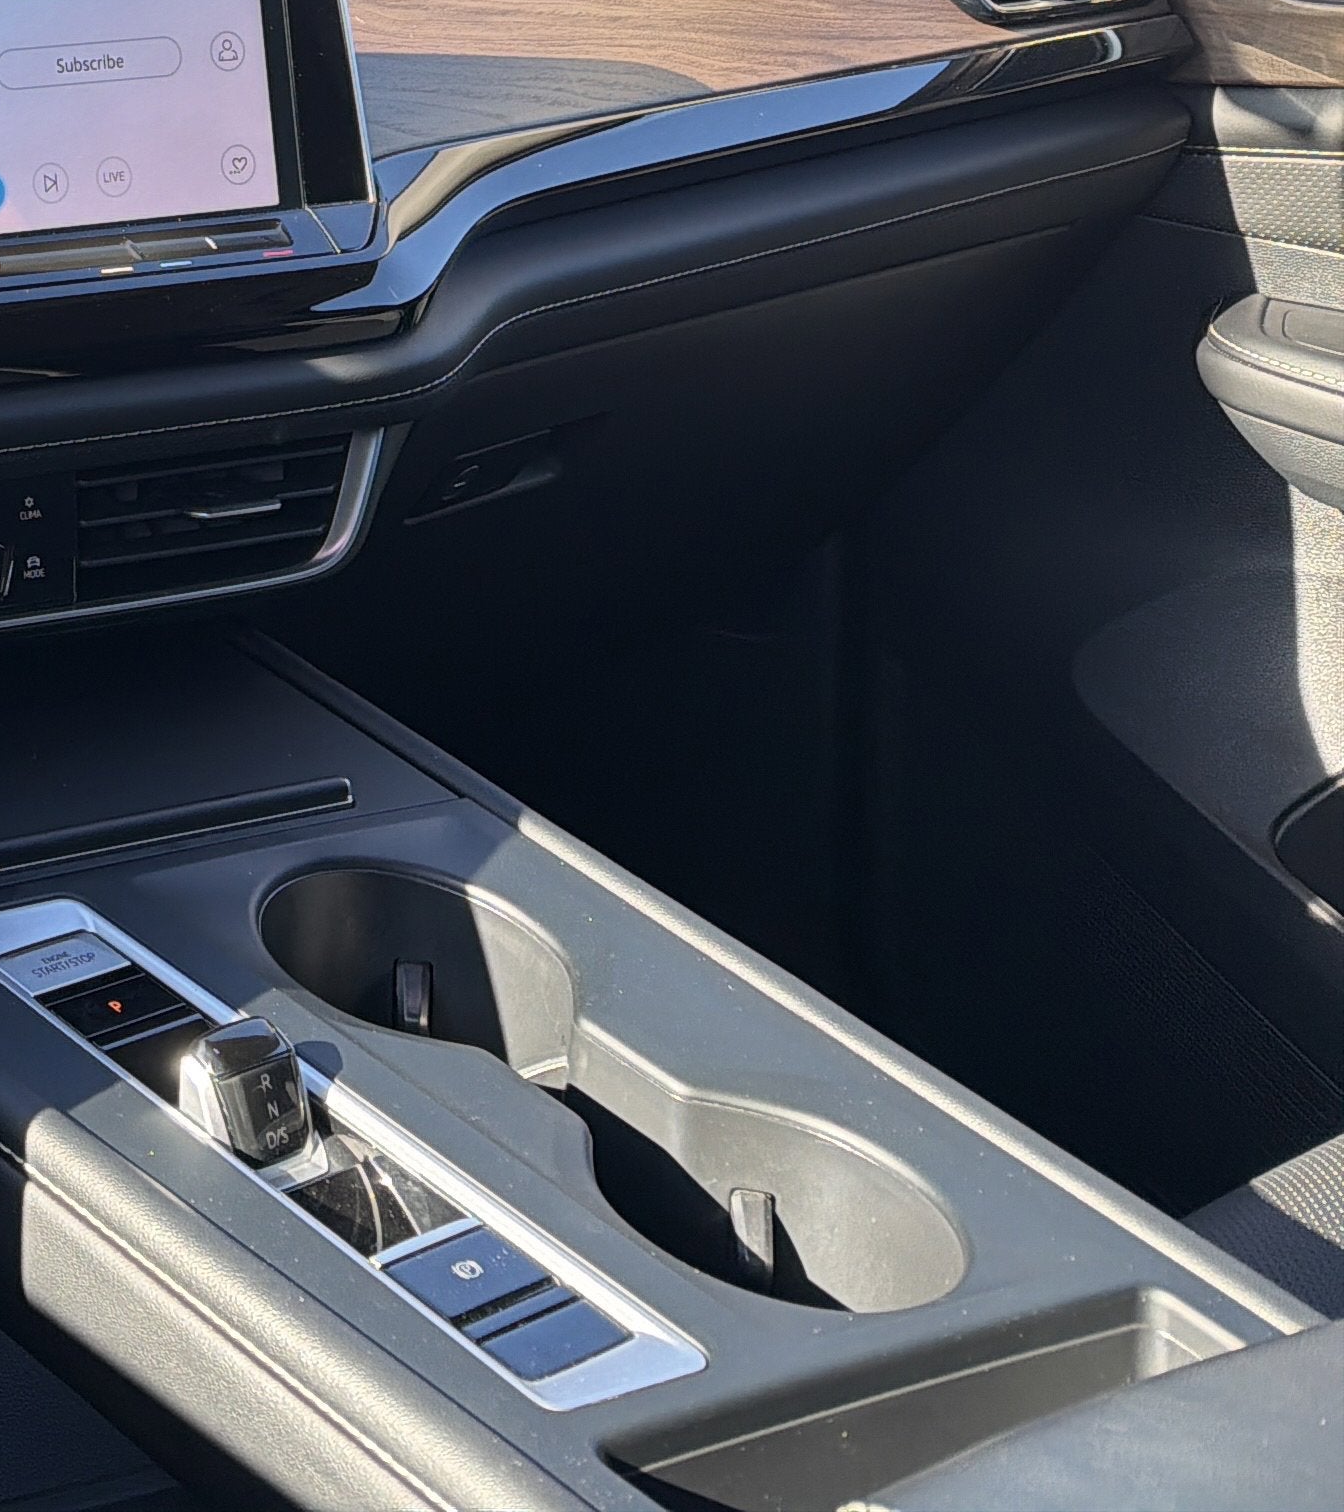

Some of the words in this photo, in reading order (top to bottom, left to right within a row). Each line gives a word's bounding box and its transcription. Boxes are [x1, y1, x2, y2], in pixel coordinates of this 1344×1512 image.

[56, 54, 125, 75] Subscribe
[103, 171, 125, 183] LIVE
[19, 509, 43, 521] CLIMA
[23, 568, 46, 579] MODE
[31, 952, 96, 979] START/STOP
[108, 999, 123, 1014] P
[260, 1073, 273, 1090] R
[267, 1102, 279, 1119] N
[265, 1125, 290, 1150] D/S
